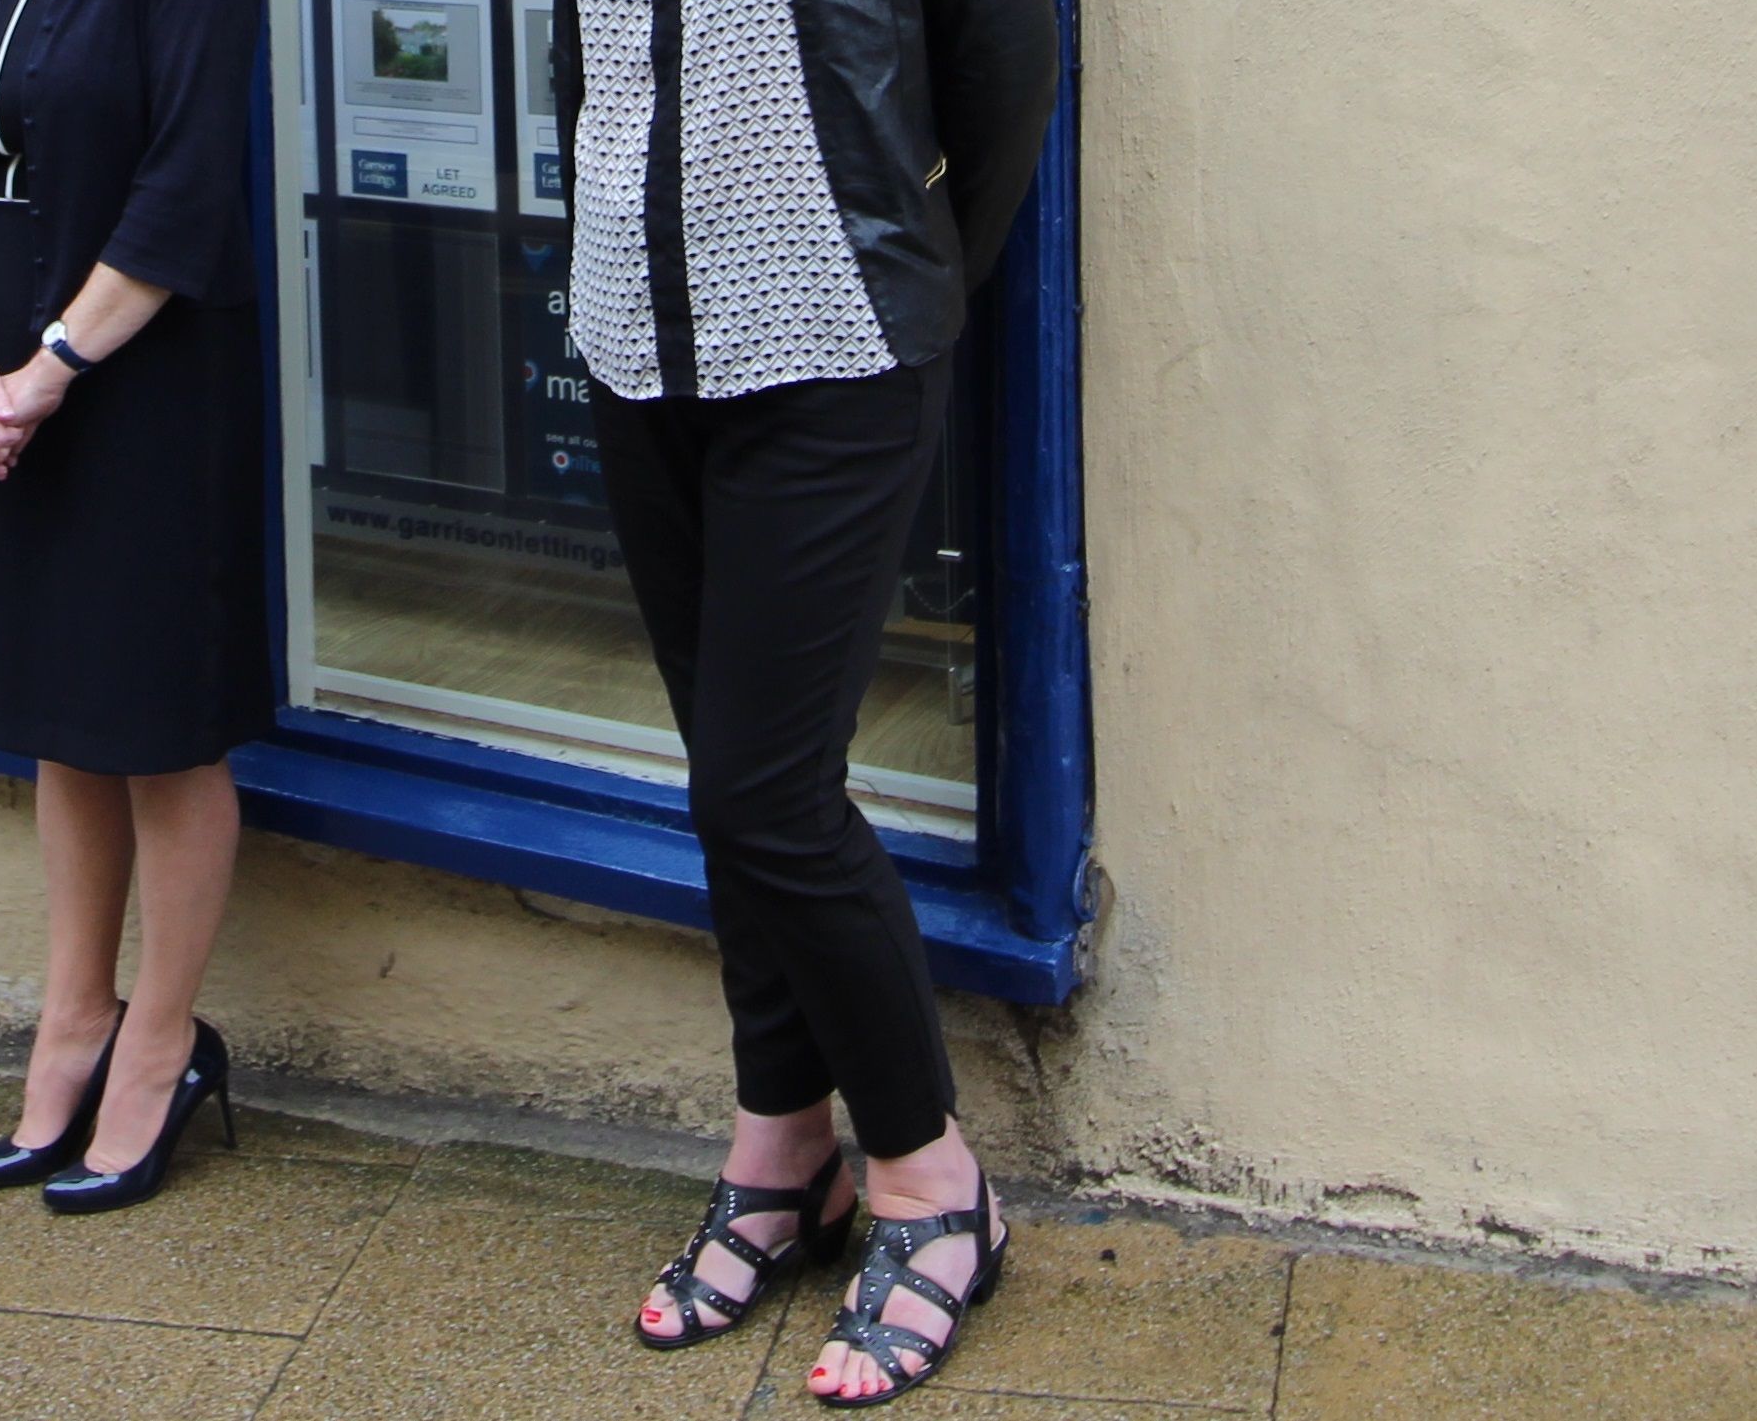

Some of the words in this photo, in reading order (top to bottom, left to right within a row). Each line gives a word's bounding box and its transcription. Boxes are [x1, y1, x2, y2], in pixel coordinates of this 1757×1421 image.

[436, 167, 460, 182] LET
[421, 183, 477, 199] AGREED
[326, 504, 626, 570] www.garrisonlettings
